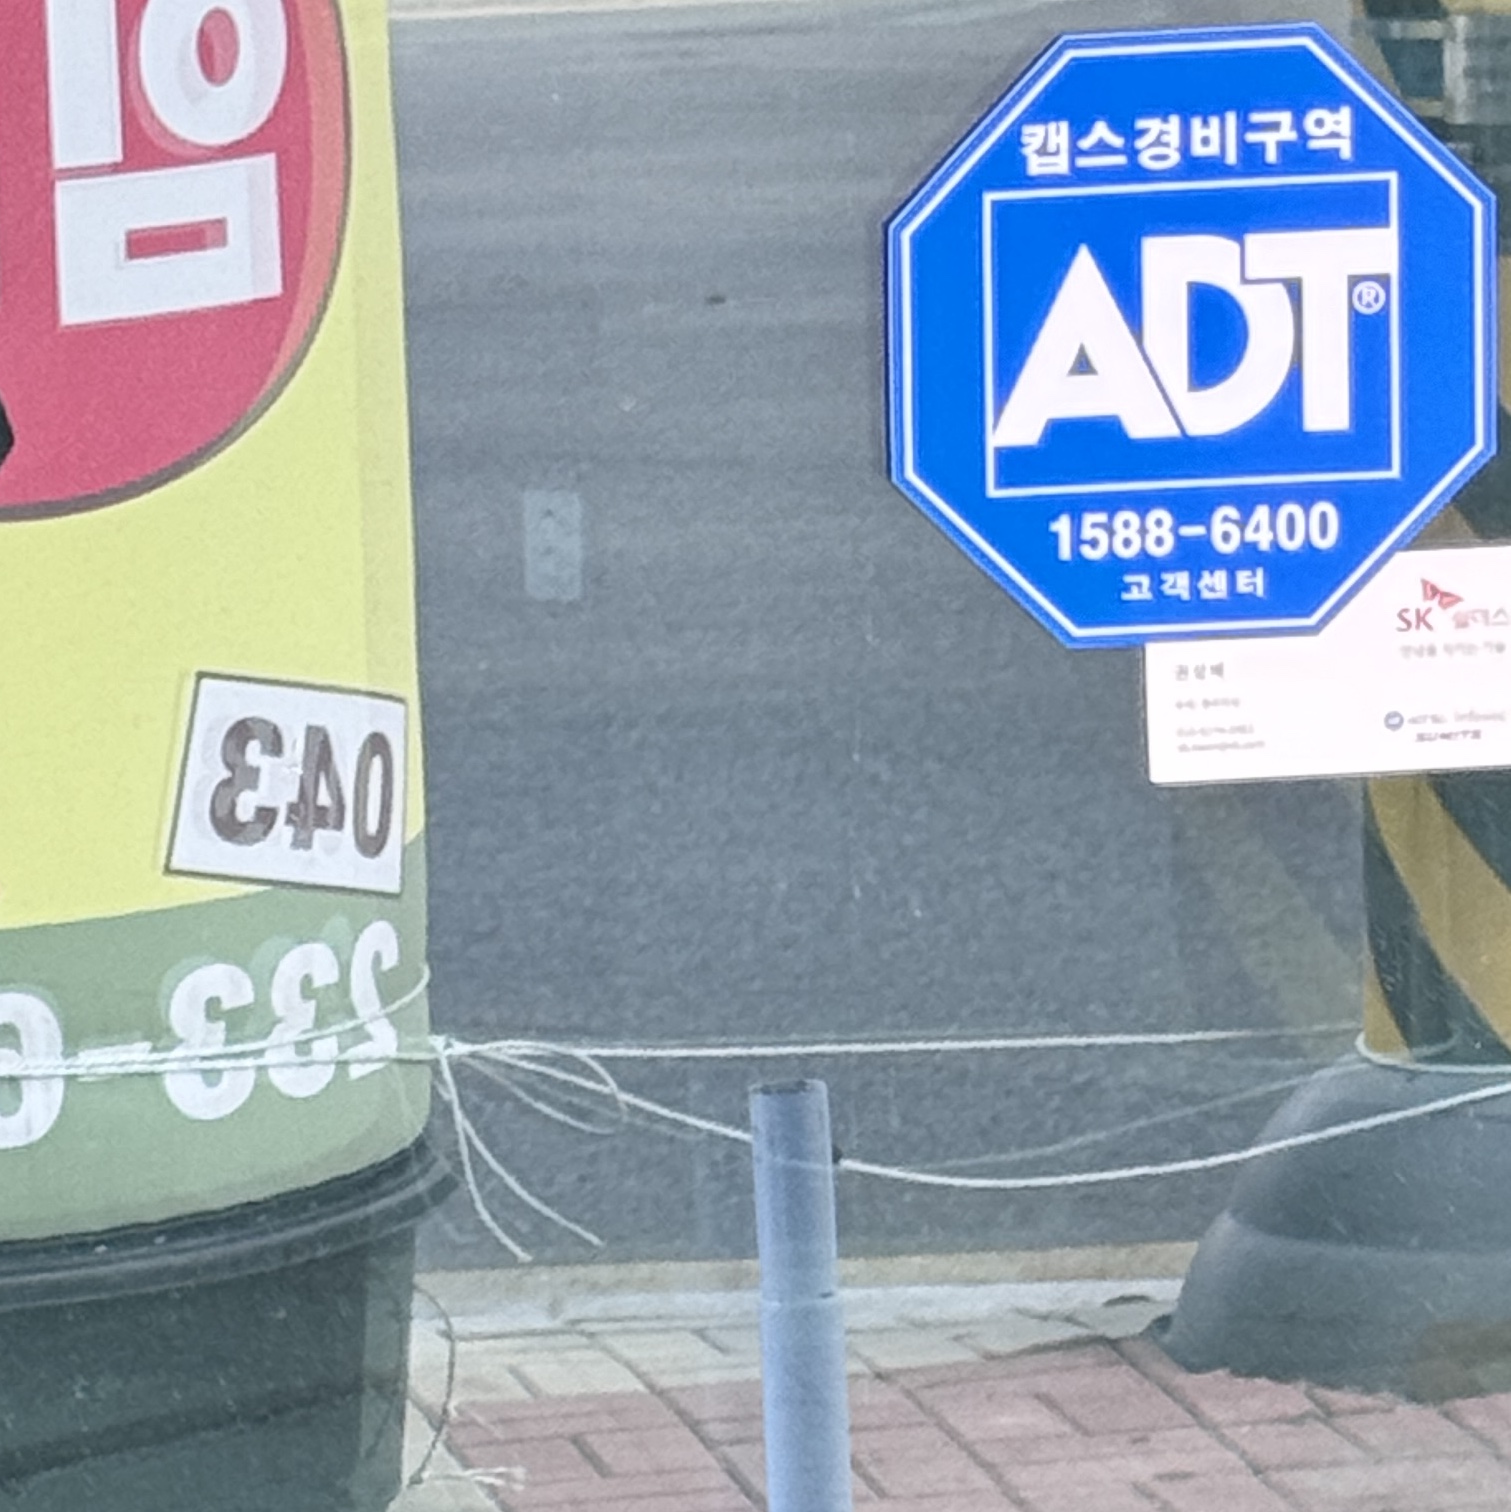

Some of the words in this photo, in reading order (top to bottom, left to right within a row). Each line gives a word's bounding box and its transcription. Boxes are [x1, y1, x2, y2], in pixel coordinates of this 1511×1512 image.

[1020, 104, 1352, 177] 캡스경비구역
[992, 226, 1394, 447] ADT
[1048, 501, 1339, 561] 1588-6400
[1120, 566, 1265, 601] 고객센터
[1396, 606, 1434, 632] SK
